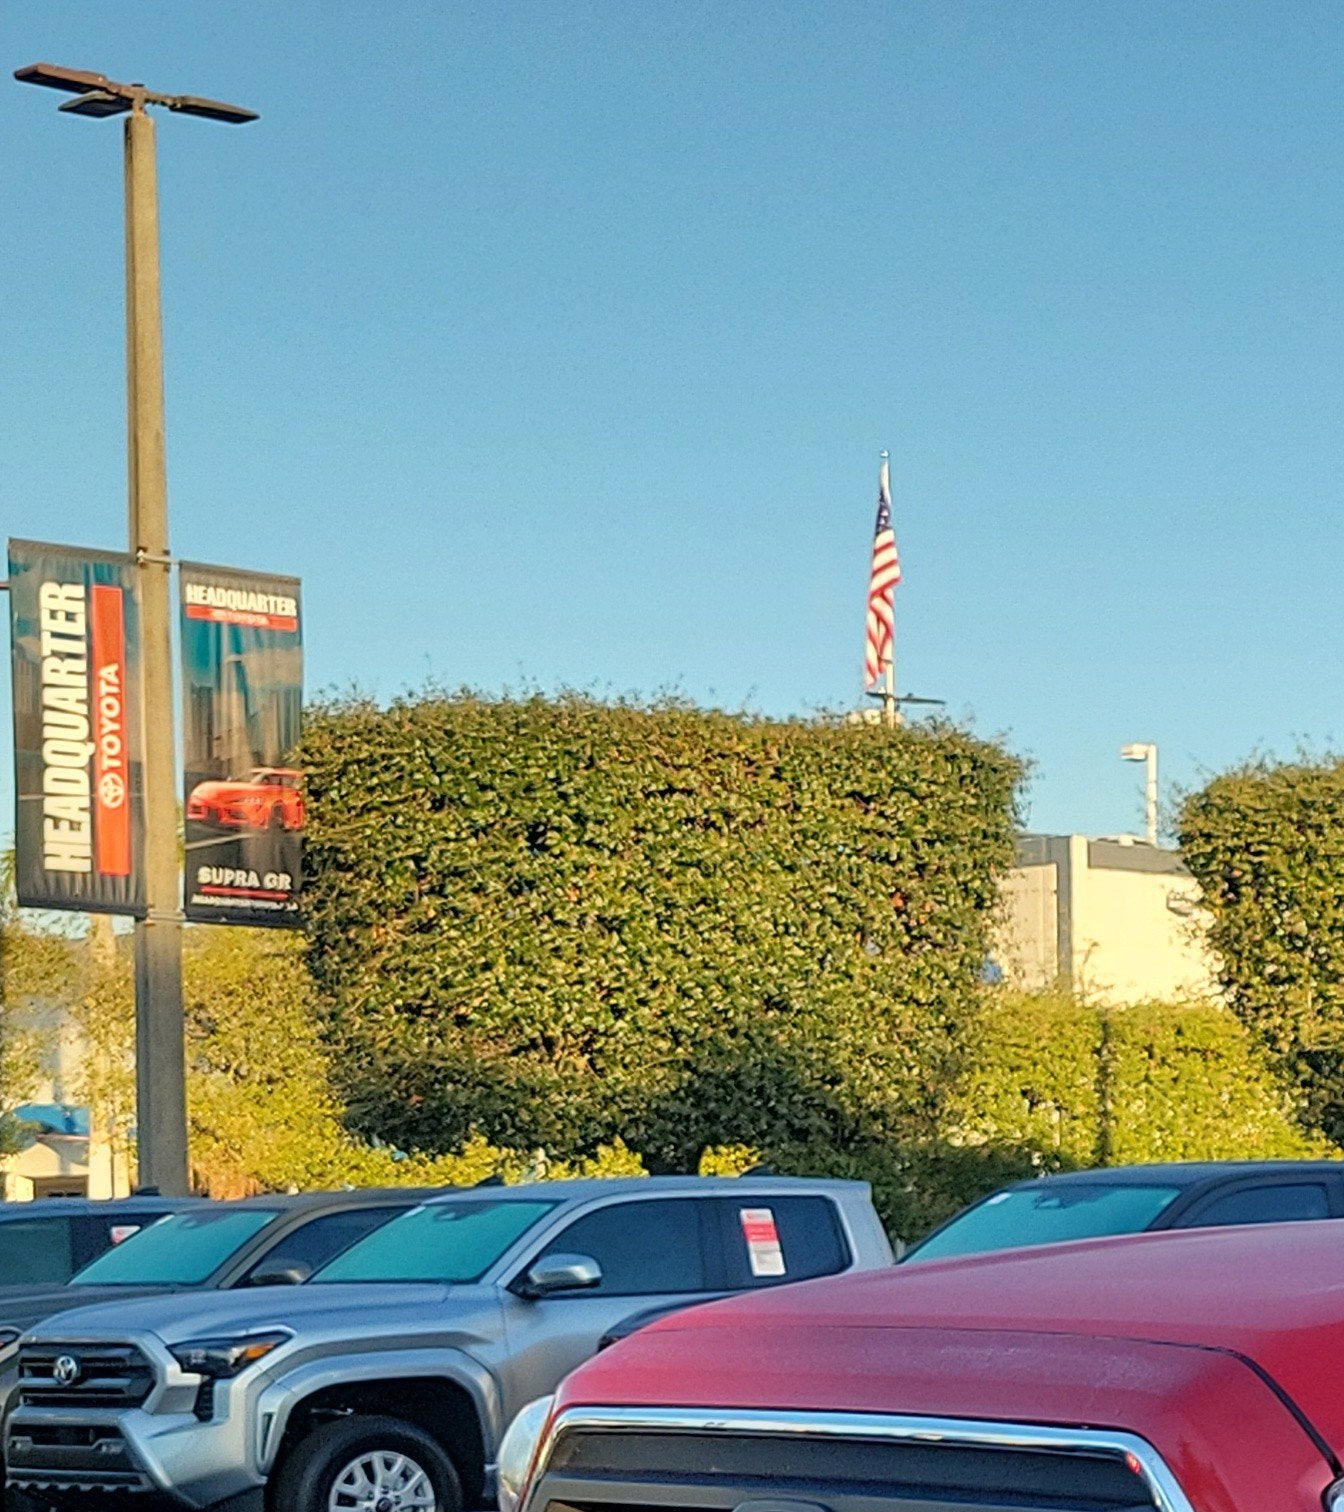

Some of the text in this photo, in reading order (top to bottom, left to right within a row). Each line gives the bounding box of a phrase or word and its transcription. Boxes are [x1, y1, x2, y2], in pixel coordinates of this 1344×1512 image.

[185, 582, 298, 617] HEADQUARTER
[39, 581, 95, 873] HEADQUARTER
[99, 662, 123, 770] TOYOTA
[197, 865, 292, 891] SUPRA GR
